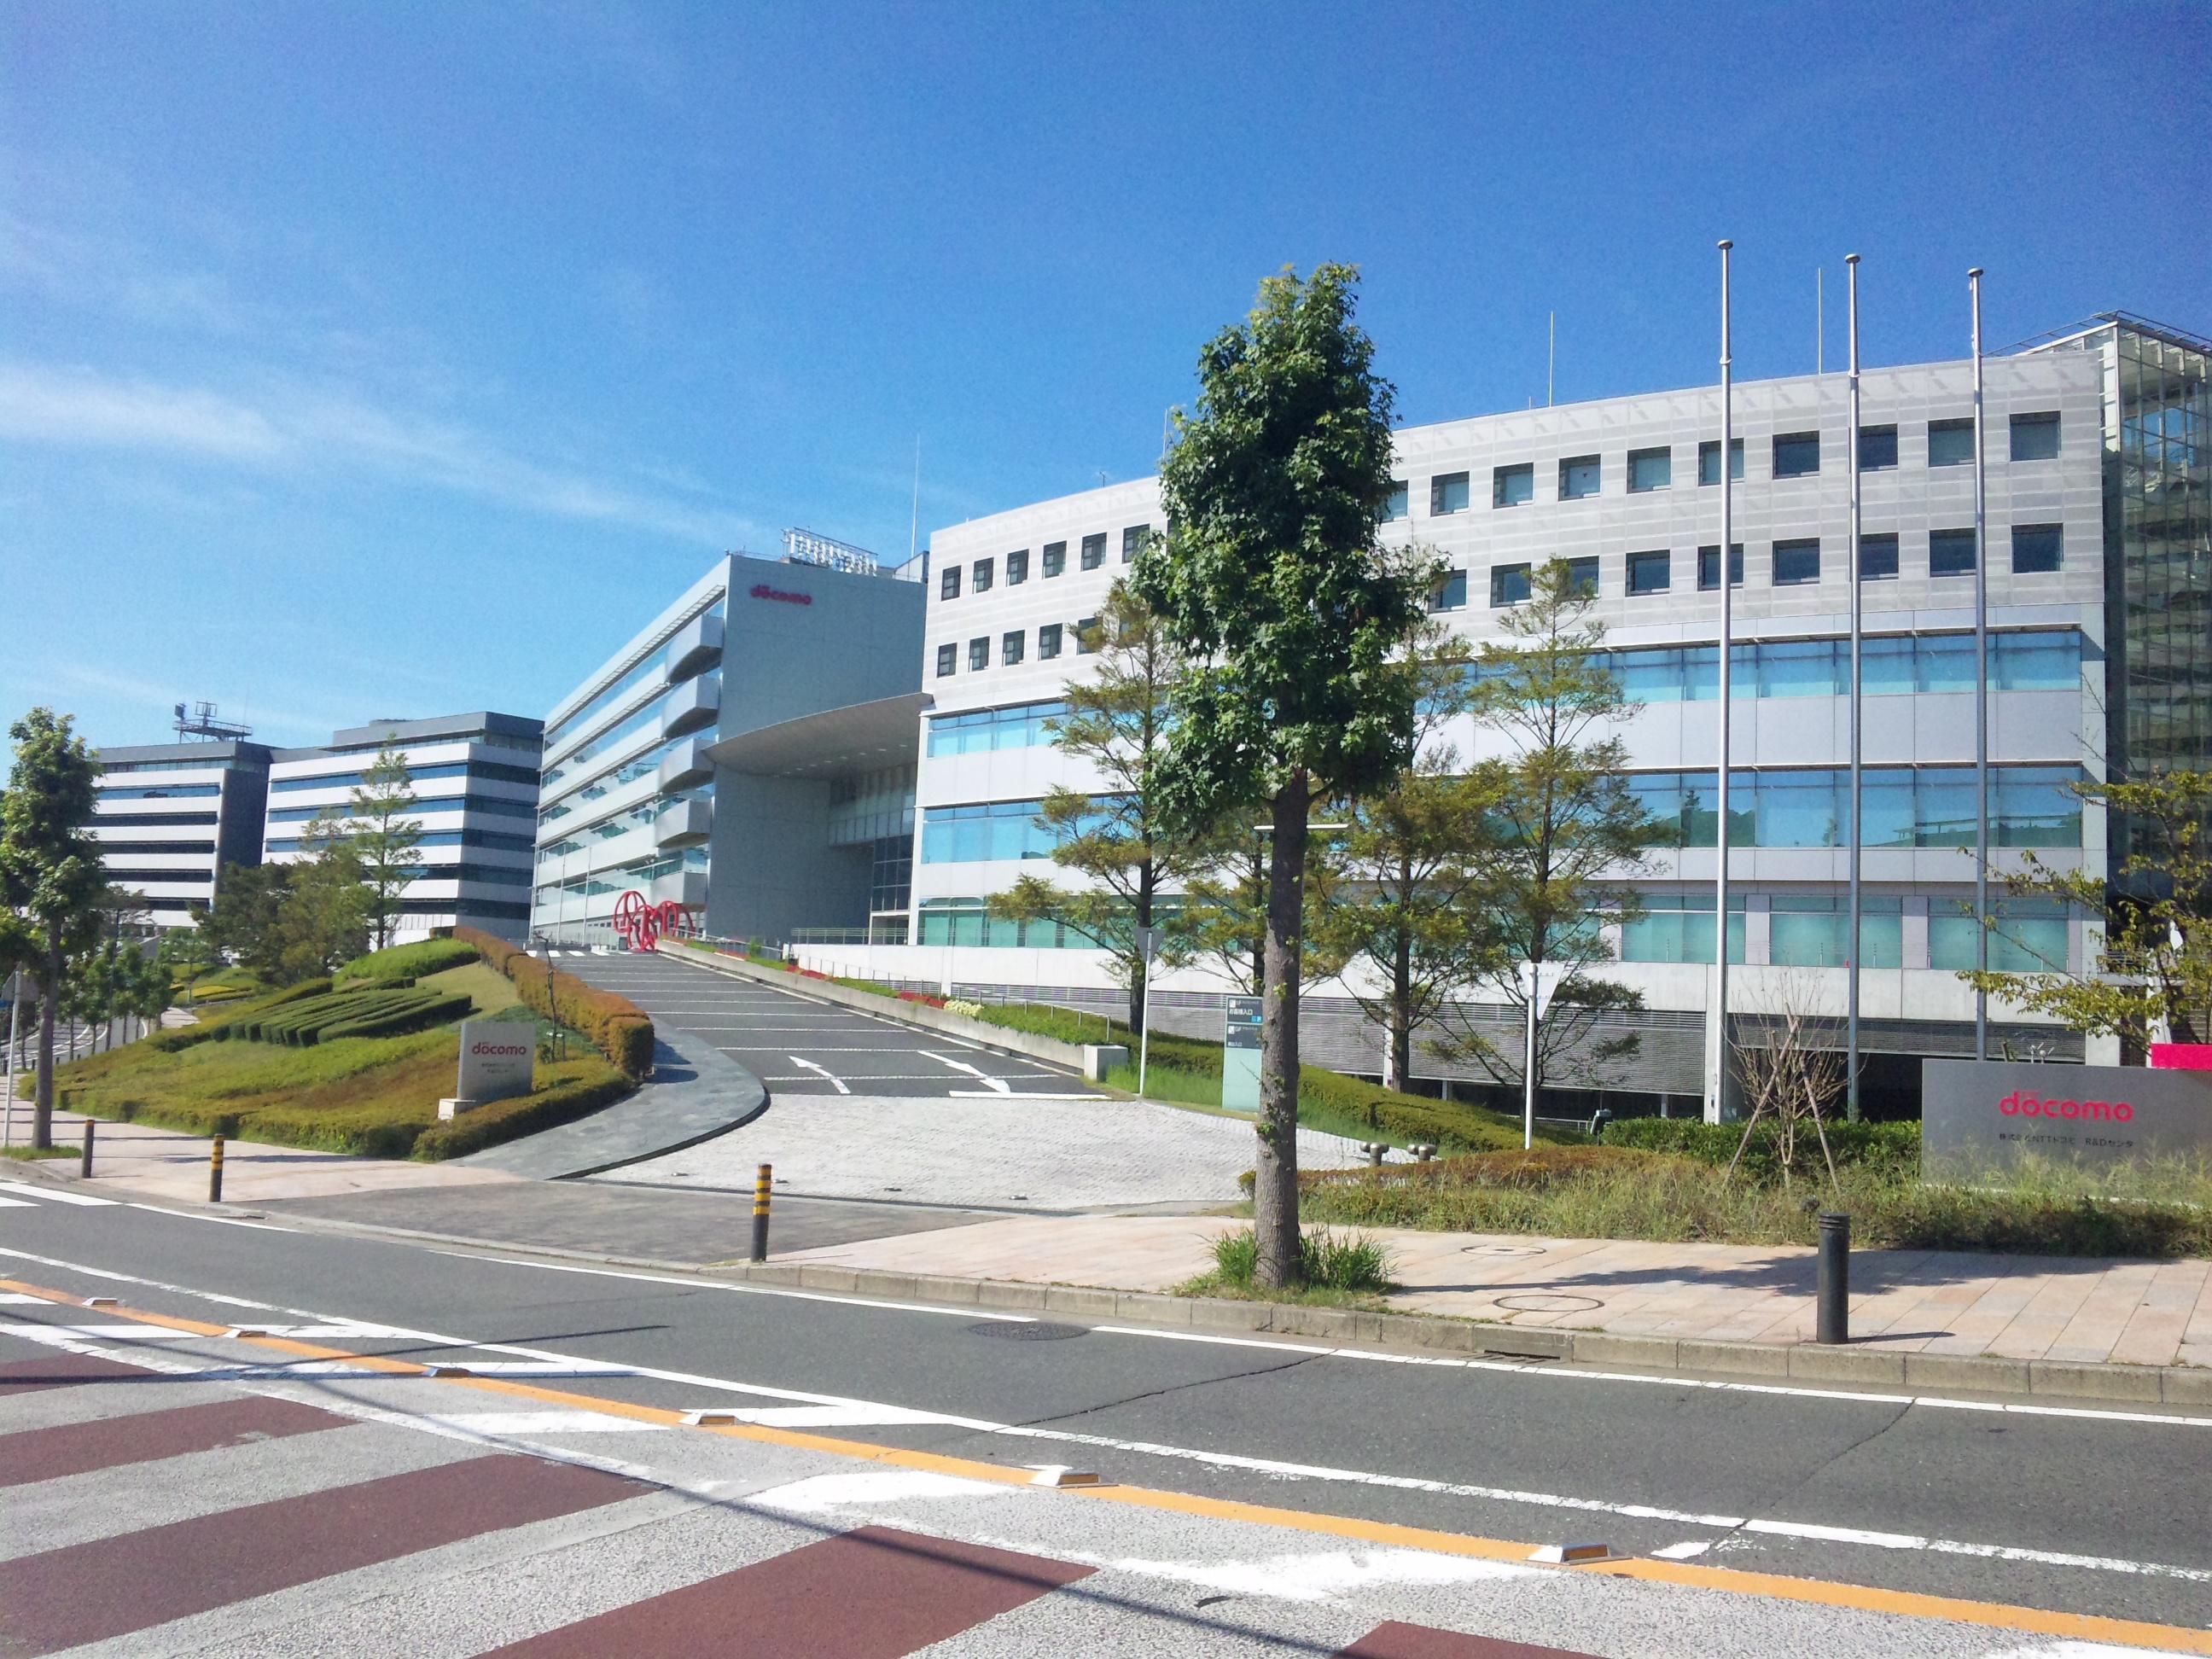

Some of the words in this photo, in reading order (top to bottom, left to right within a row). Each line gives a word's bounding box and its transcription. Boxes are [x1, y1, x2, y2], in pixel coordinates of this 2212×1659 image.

[749, 585, 812, 605] docomo
[472, 1042, 527, 1056] docomo
[1999, 1091, 2134, 1123] docomo
